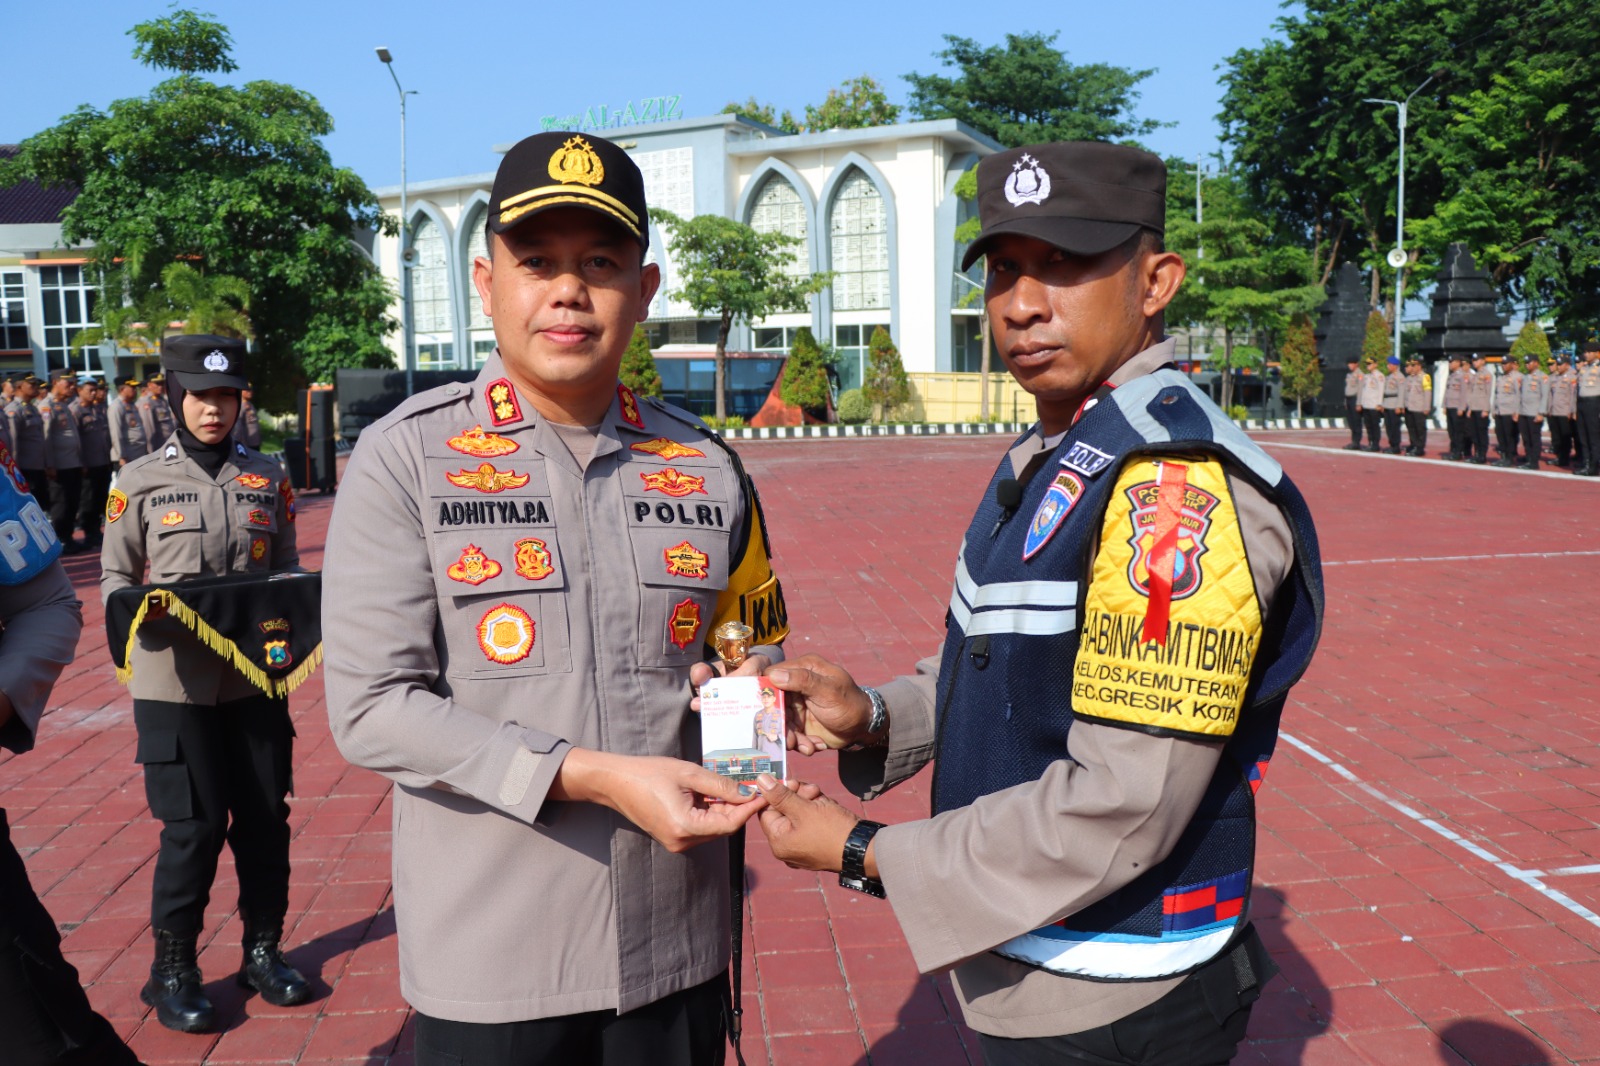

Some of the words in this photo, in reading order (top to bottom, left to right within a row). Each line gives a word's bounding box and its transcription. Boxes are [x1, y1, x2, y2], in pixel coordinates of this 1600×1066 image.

[582, 95, 683, 129] AL-AZIZ
[150, 492, 198, 508] SHANTI
[235, 492, 275, 506] POLRI
[1137, 486, 1208, 506] POES
[634, 501, 724, 527] POLRI
[1076, 660, 1240, 701] KEL/DS.KEMUTERAN
[1074, 681, 1183, 716] KEC.GRESIK
[1192, 701, 1236, 723] KOTA
